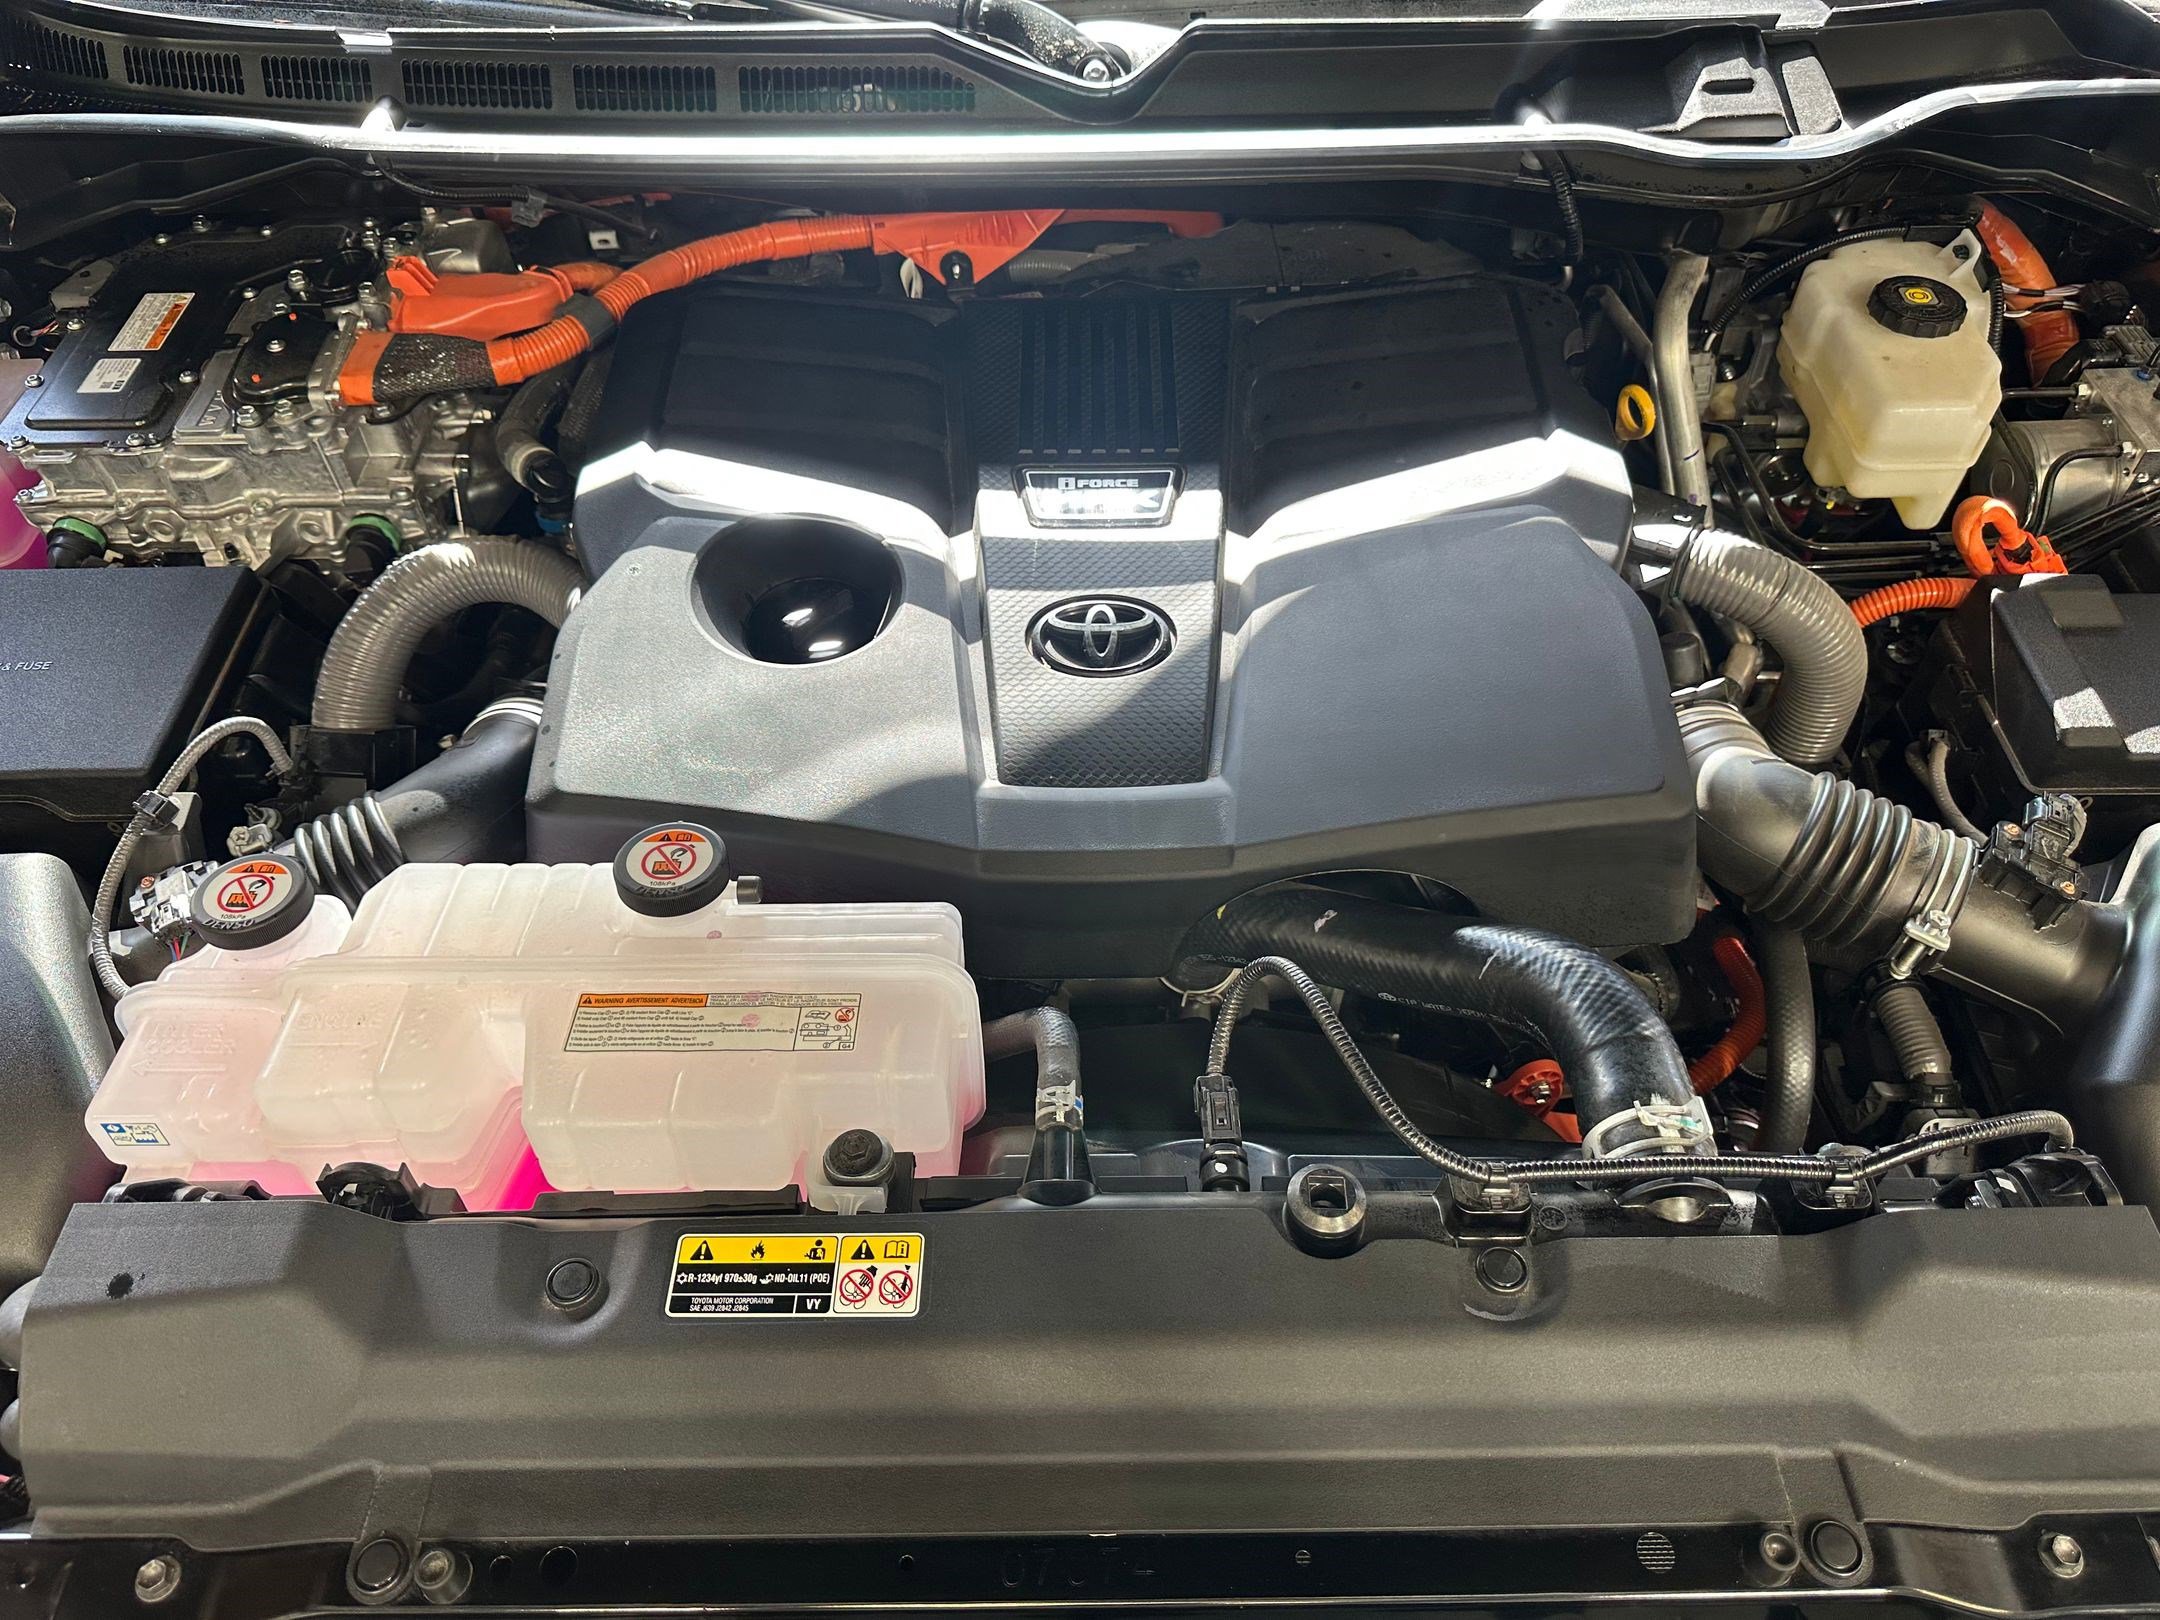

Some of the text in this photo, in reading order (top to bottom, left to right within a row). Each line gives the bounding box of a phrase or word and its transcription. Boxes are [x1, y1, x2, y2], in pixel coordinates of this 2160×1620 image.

[14, 661, 53, 671] FUSE
[202, 919, 256, 930] DENSO
[687, 1272, 830, 1285] R-1234yf 970±30g ND-OIL11 (POE)
[689, 1304, 701, 1312] SAE
[806, 1299, 821, 1310] VY
